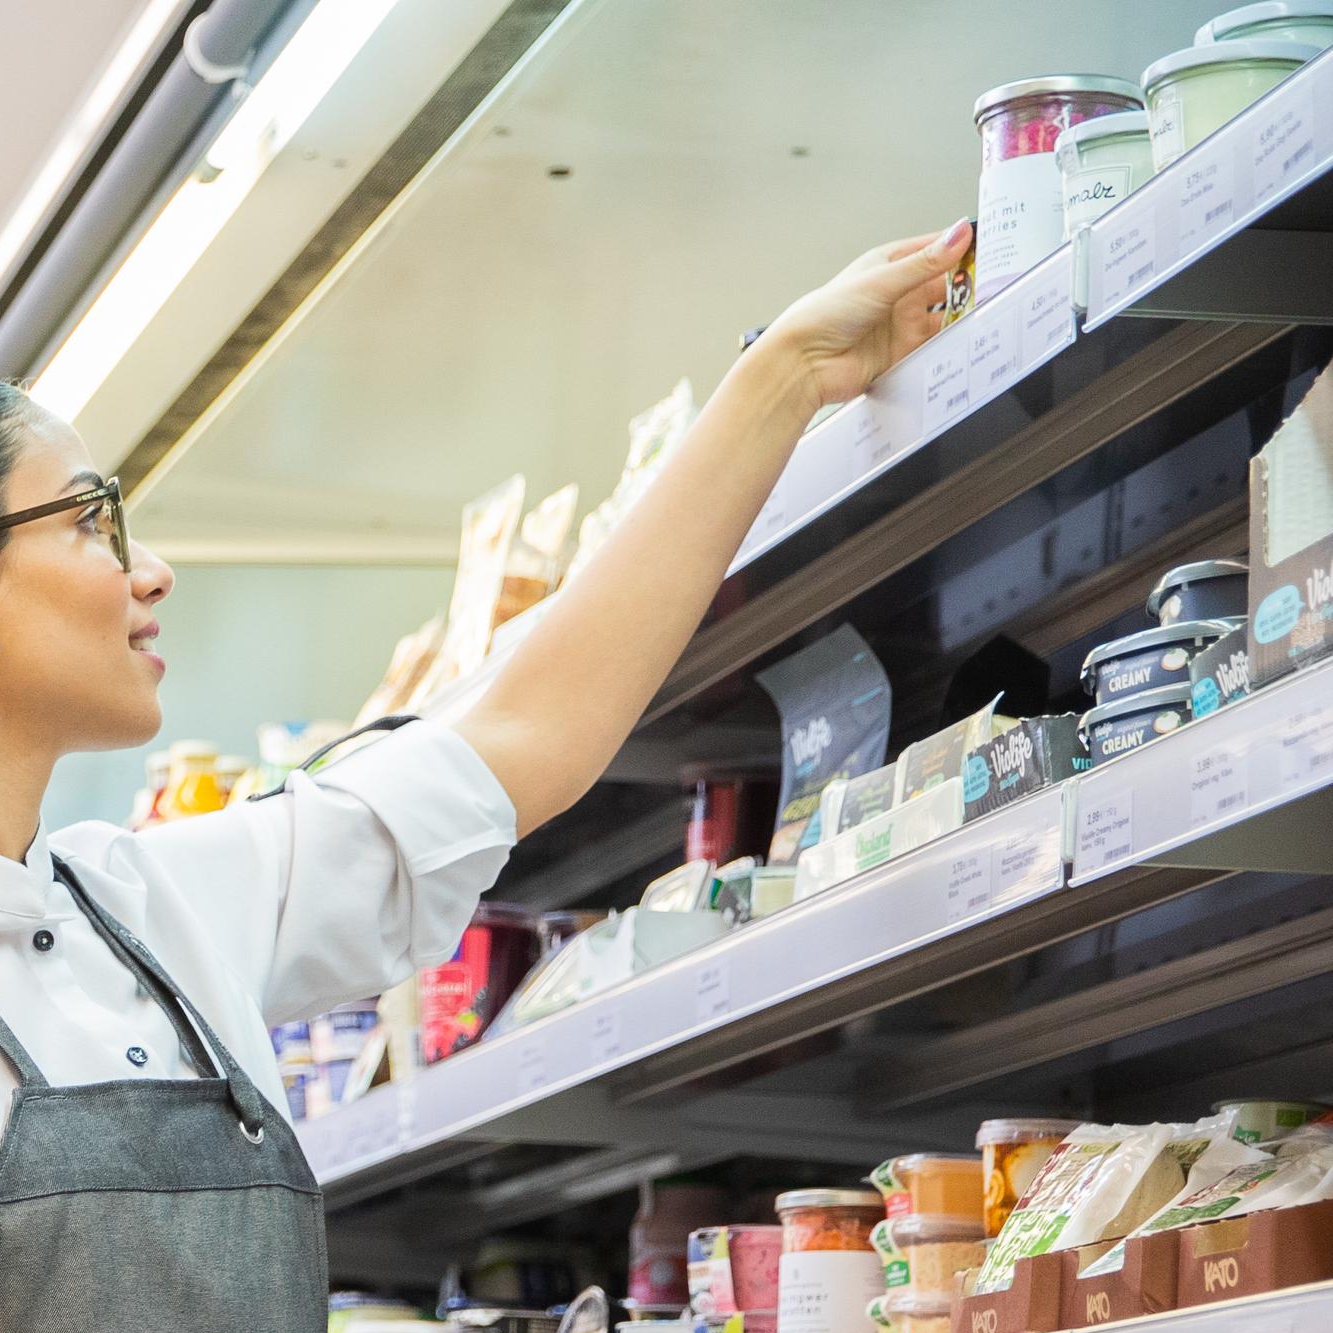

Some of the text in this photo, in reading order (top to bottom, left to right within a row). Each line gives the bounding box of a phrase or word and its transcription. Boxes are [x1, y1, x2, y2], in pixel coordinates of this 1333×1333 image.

[1001, 201, 1026, 217] mit
[1108, 666, 1152, 694] CREAMY
[990, 730, 1033, 779] Violife
[1101, 729, 1145, 756] CREAMY
[1203, 1257, 1239, 1293] KATO
[1086, 1290, 1111, 1324] KATO
